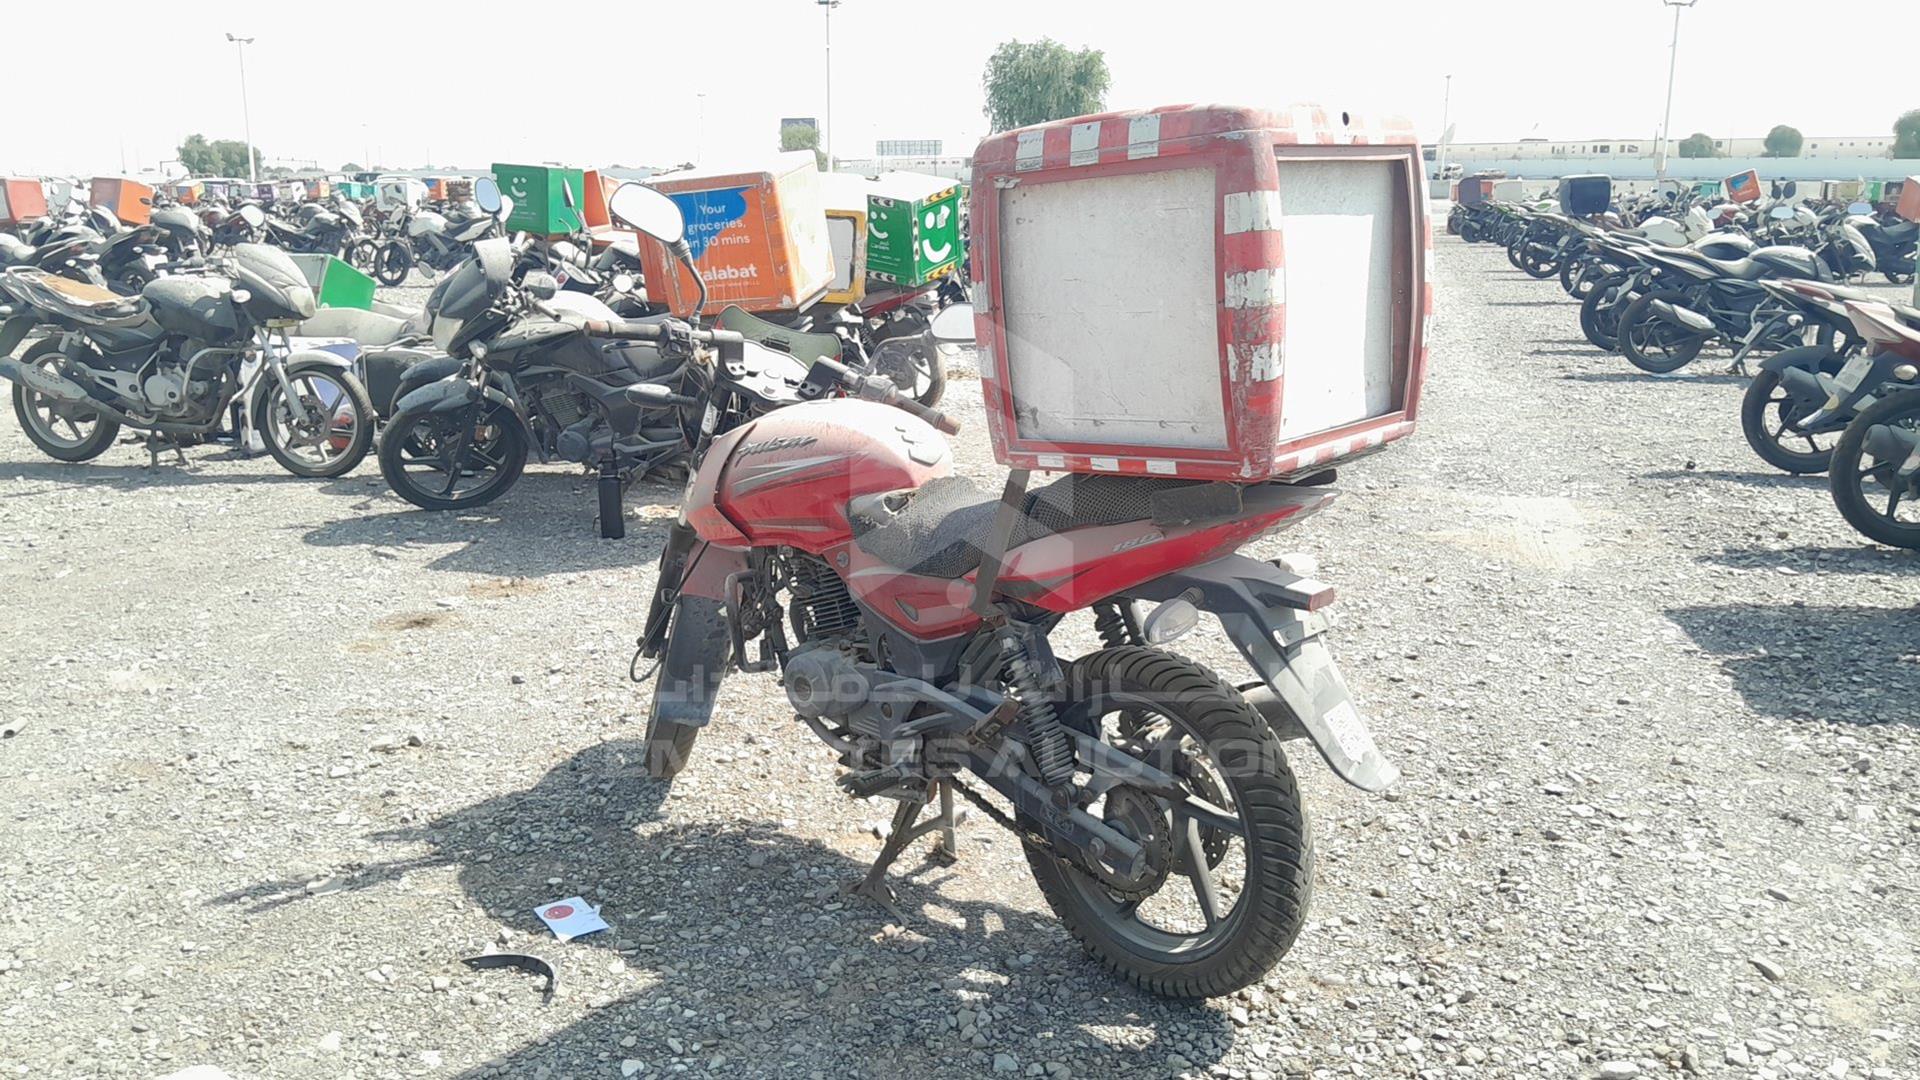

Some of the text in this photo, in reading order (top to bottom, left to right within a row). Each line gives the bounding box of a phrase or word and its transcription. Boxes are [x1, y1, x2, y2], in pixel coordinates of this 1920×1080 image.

[699, 205, 726, 215] Your
[687, 218, 747, 236] groceries,
[703, 235, 719, 248] 30
[721, 233, 751, 246] mins
[700, 263, 758, 281] alabat
